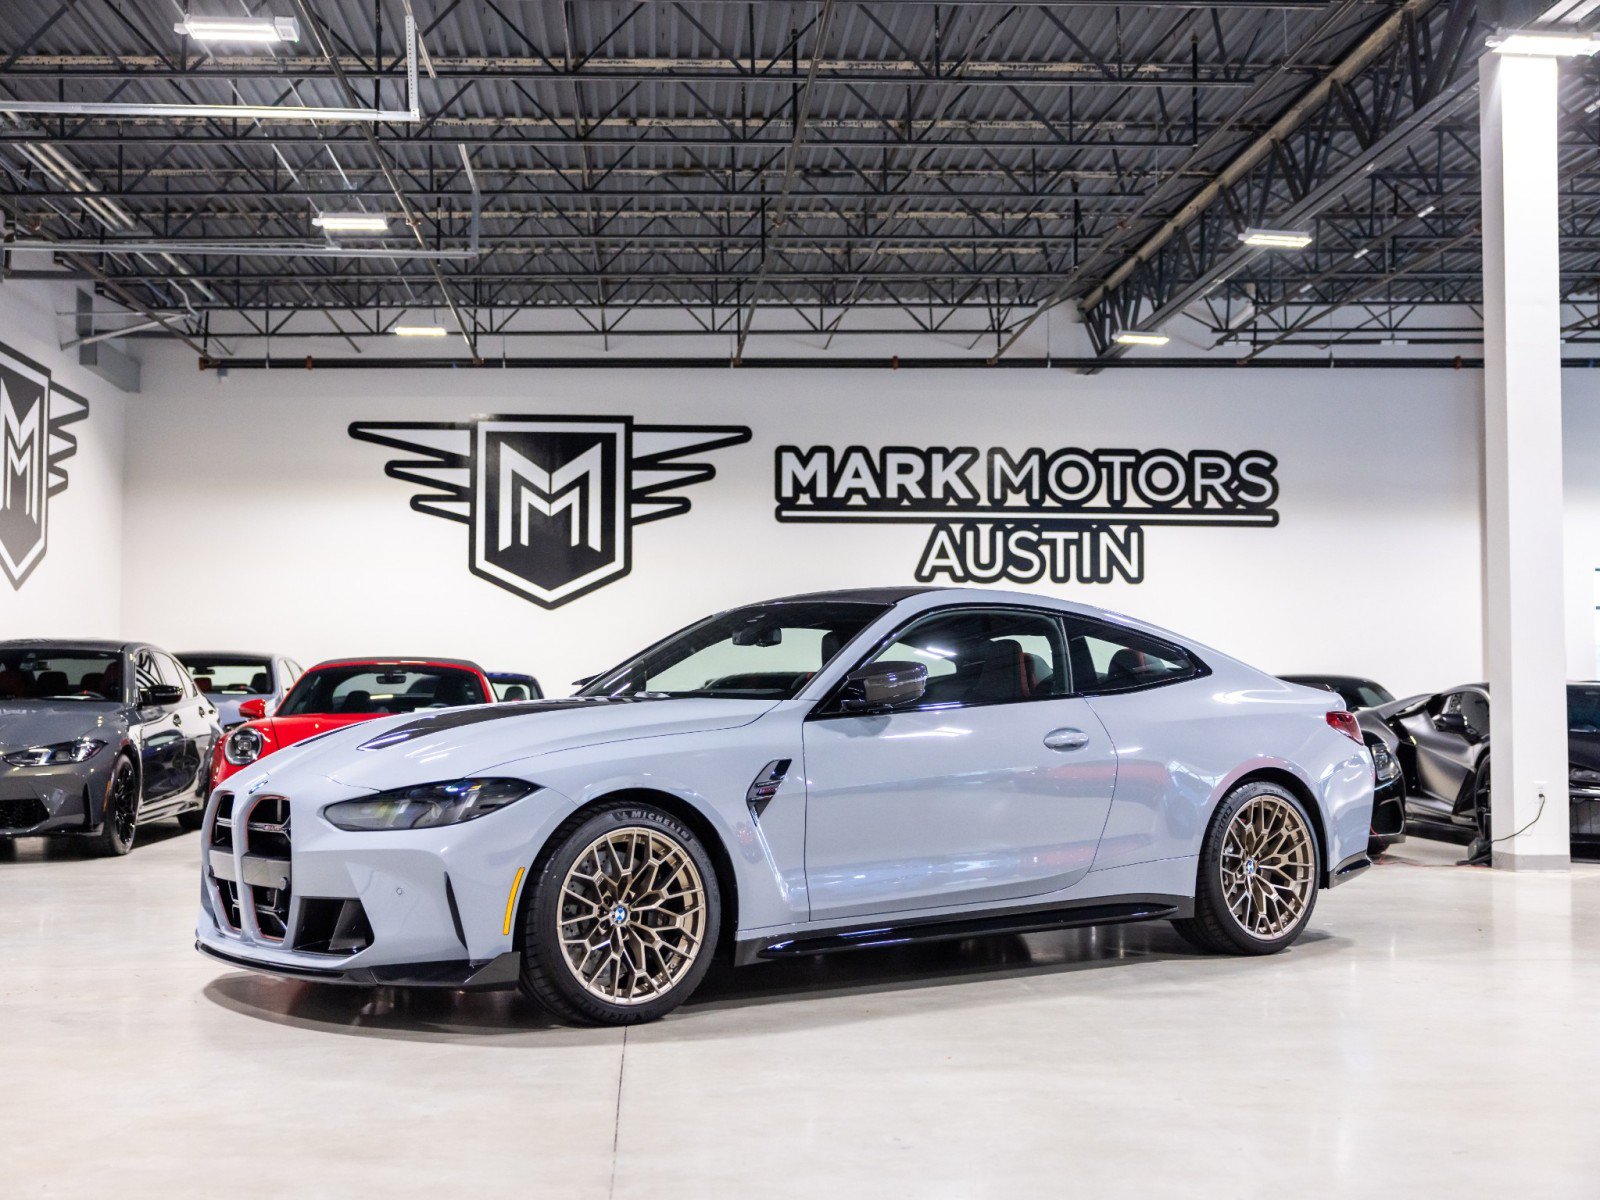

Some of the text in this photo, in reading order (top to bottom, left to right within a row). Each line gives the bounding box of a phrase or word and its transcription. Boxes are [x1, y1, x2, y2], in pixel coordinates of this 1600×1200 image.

[780, 450, 1275, 504] MARK MOTORS
[920, 528, 1140, 580] AUSTIN
[631, 810, 690, 839] MICHELIN
